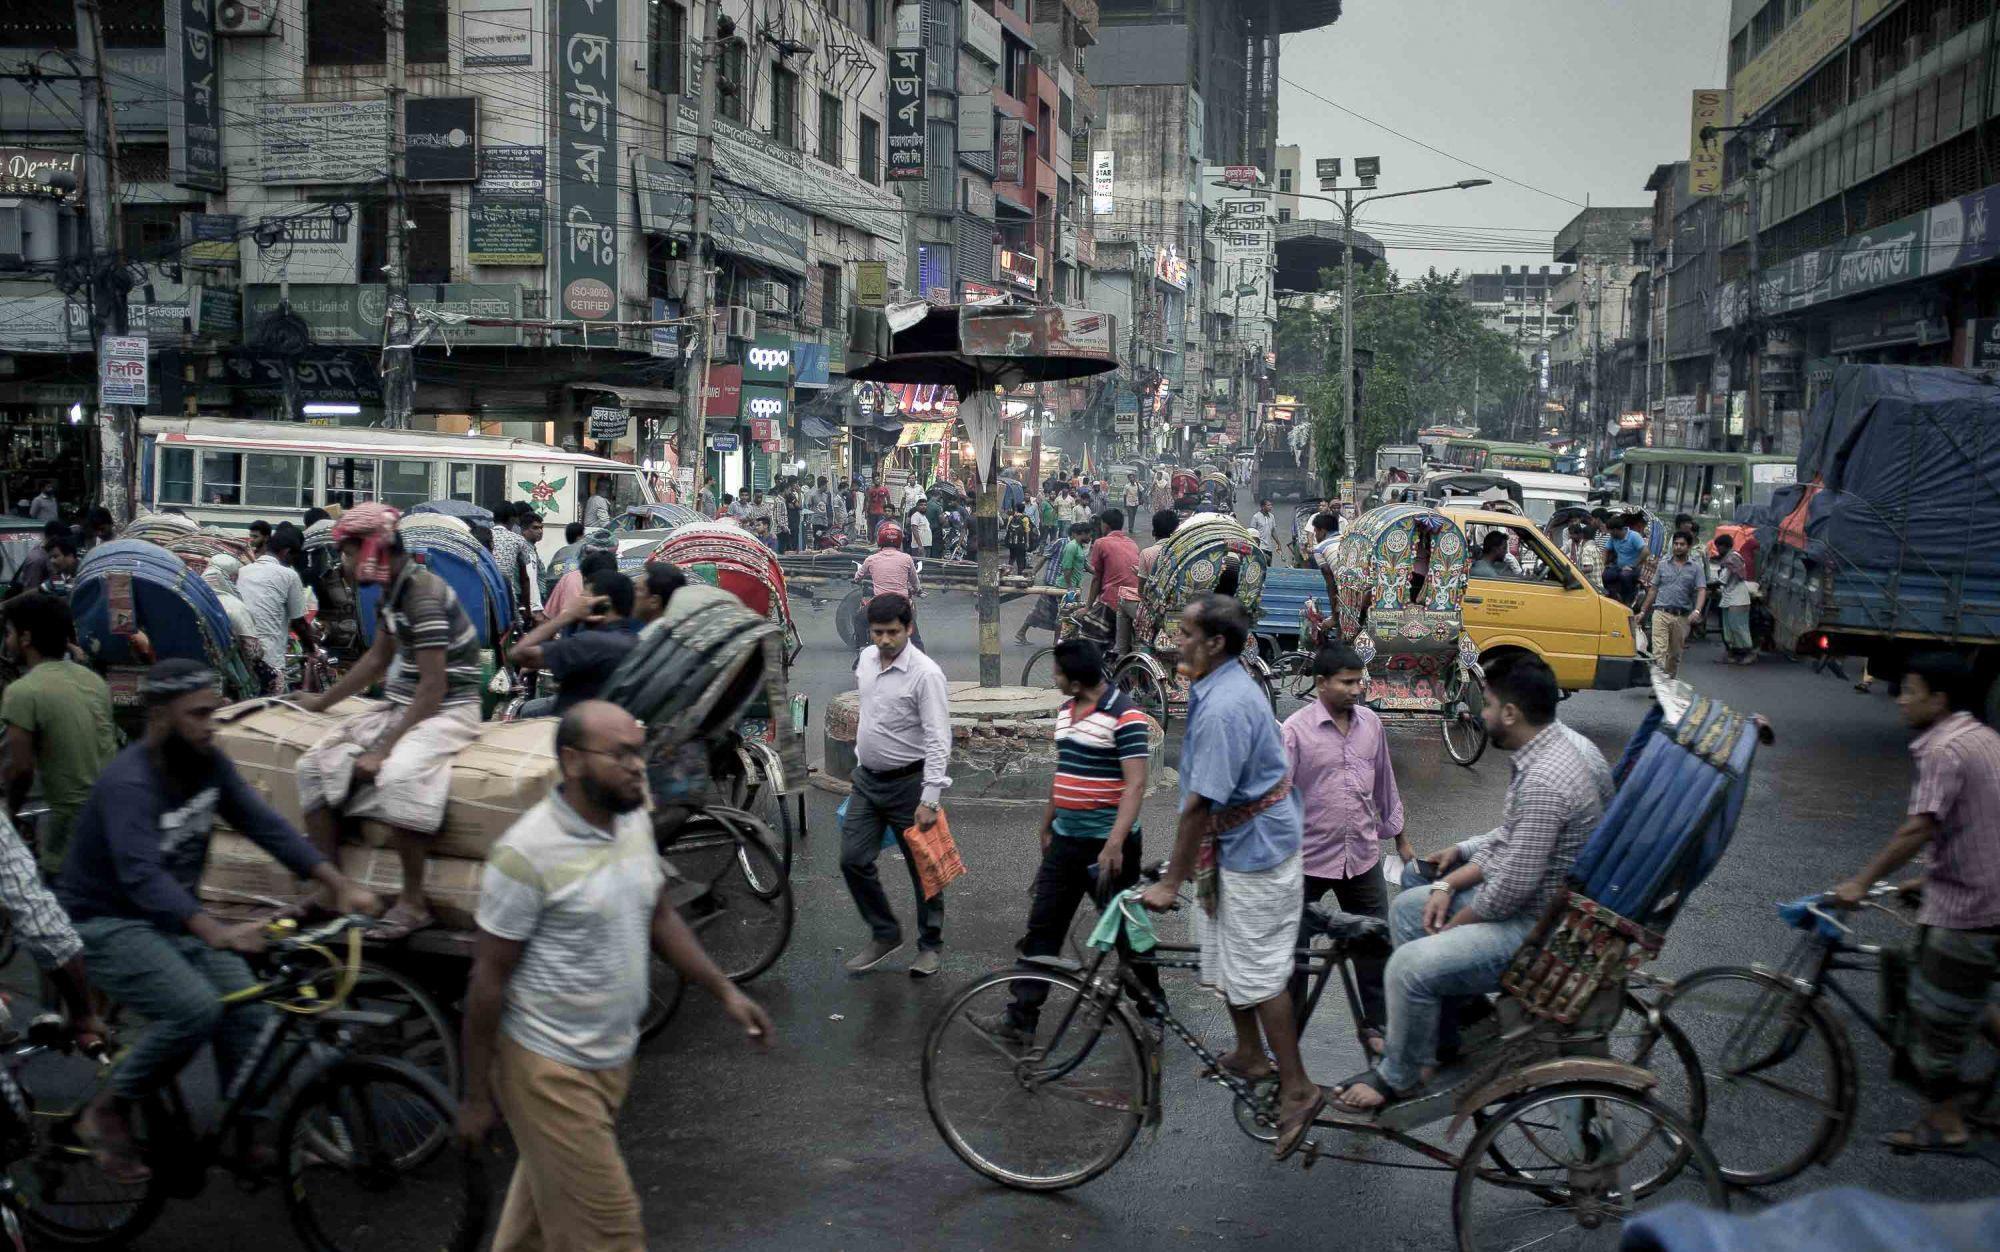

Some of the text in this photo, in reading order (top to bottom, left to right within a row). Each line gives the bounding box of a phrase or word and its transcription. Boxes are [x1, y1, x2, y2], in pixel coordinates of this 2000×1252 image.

[570, 299, 610, 312] CETIFIED
[749, 347, 788, 372] oppo
[750, 398, 782, 419] oppo
